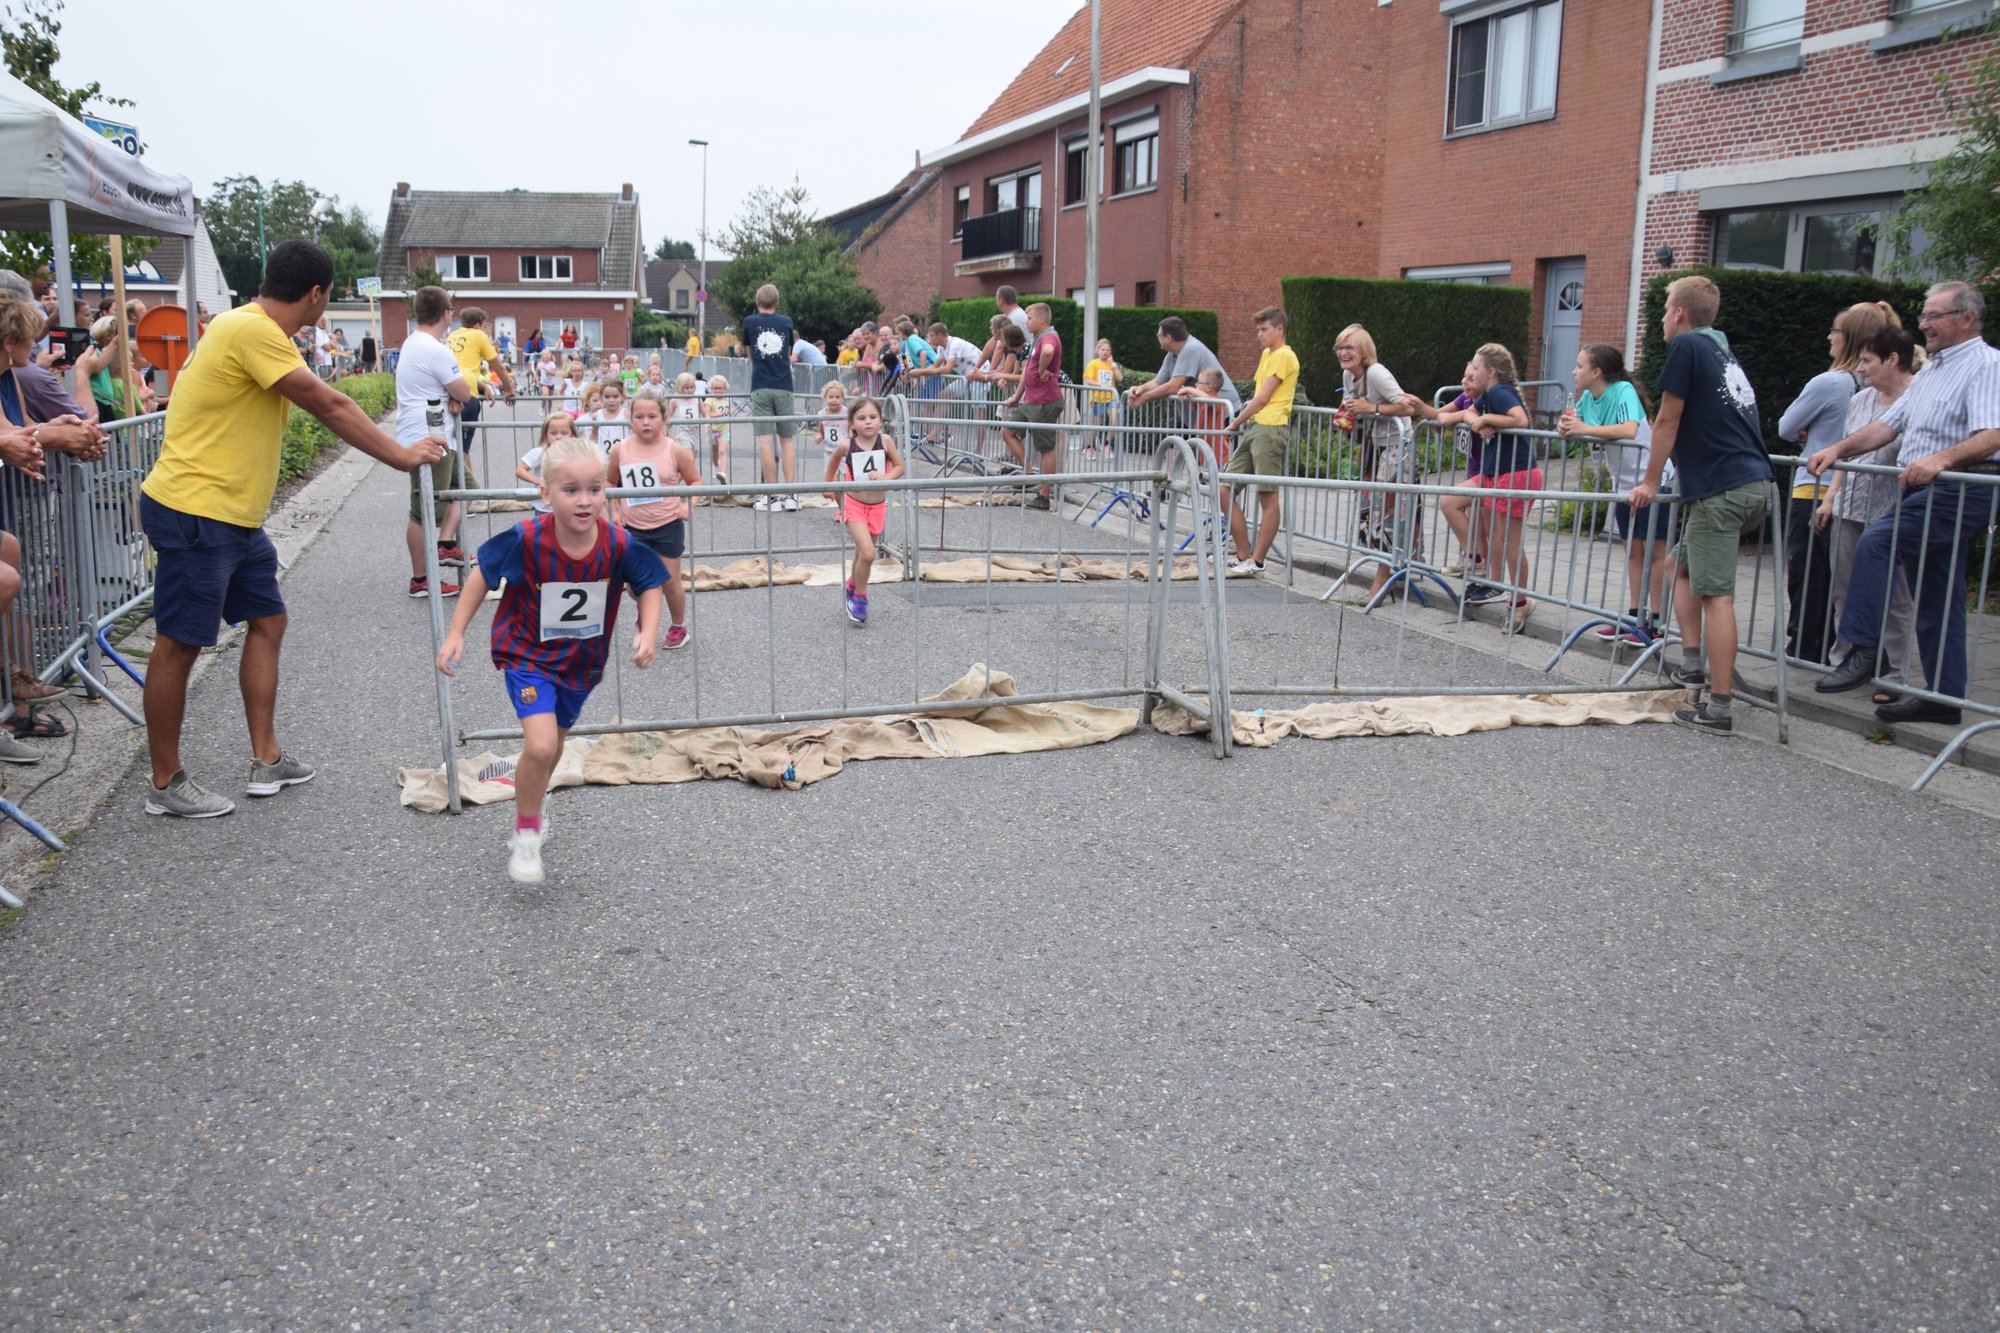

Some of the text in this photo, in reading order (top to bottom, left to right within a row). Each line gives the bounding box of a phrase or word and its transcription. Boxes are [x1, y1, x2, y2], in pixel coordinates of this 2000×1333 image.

[626, 380, 635, 388] 28
[685, 408, 694, 419] 5
[830, 428, 839, 442] 8
[862, 455, 878, 474] 4
[626, 466, 656, 488] 18
[559, 588, 588, 622] 2
